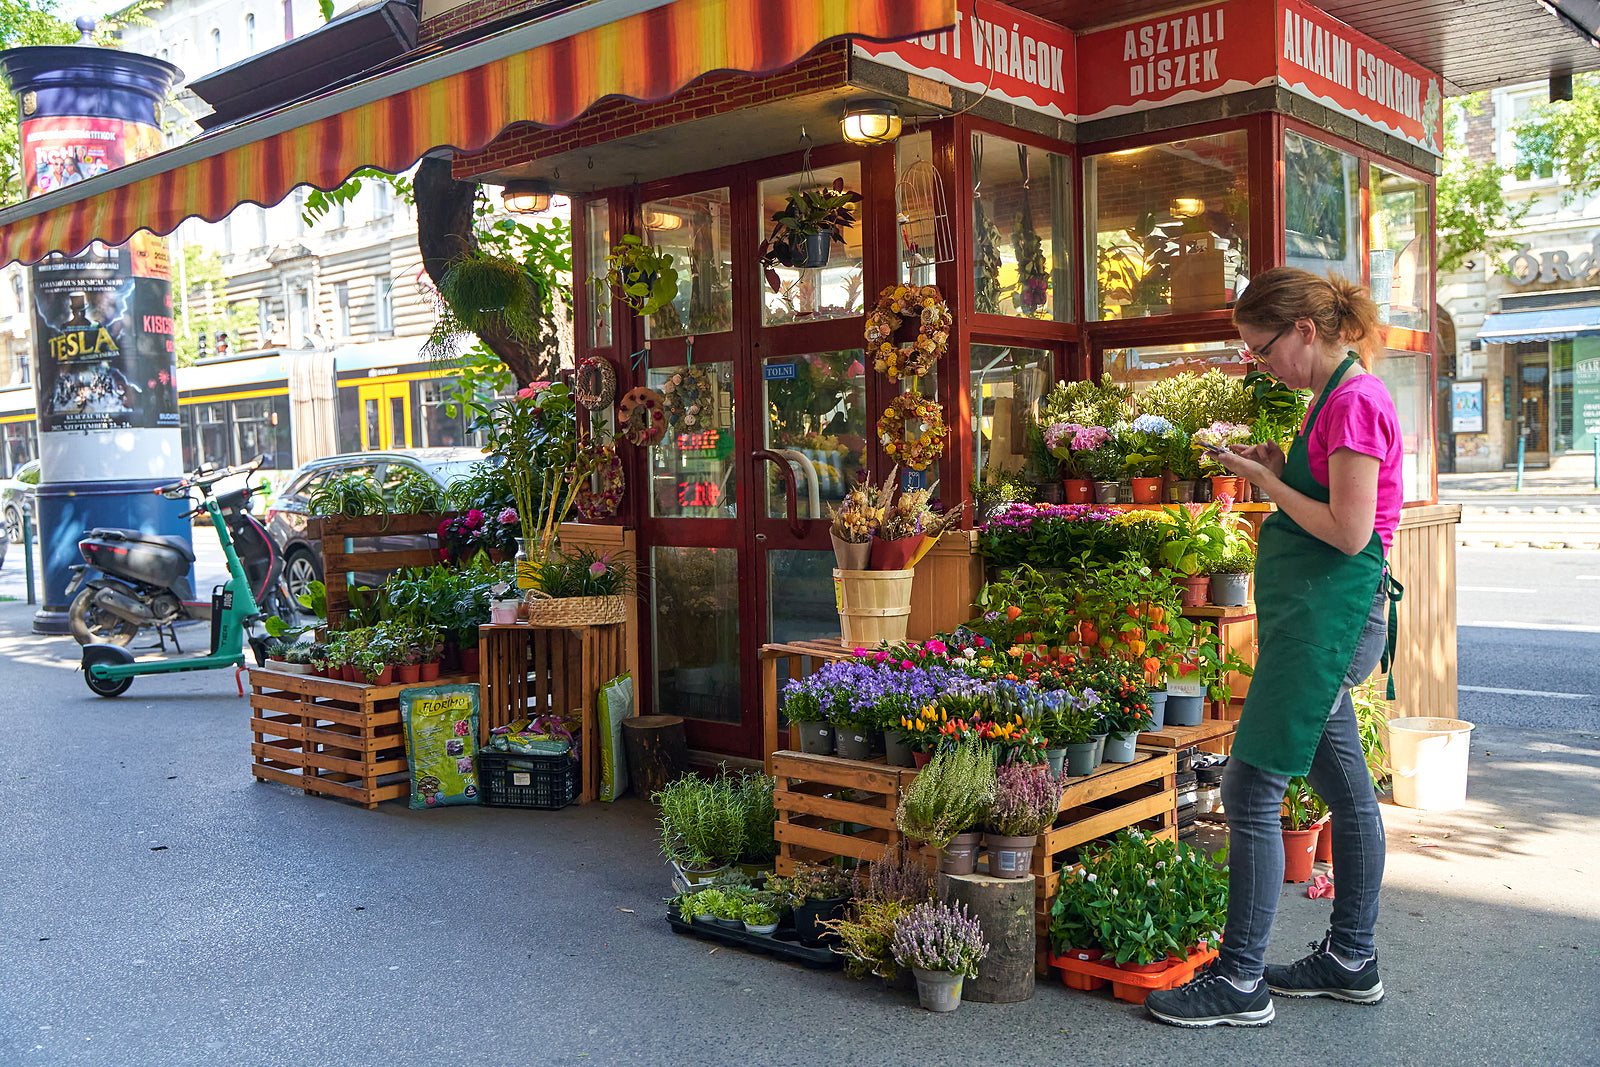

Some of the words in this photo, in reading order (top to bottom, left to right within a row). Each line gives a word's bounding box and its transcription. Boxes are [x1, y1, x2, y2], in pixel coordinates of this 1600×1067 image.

[970, 15, 1065, 95] VIRÁGOK
[1123, 8, 1224, 62] ASZTALI
[1130, 47, 1219, 97] DÍSZEK
[1283, 8, 1352, 90] ALKALMI
[1356, 47, 1421, 123] CSOKROK
[48, 327, 118, 361] TESLA
[766, 366, 793, 377] TOLNI
[423, 699, 465, 713] FLORIMO
